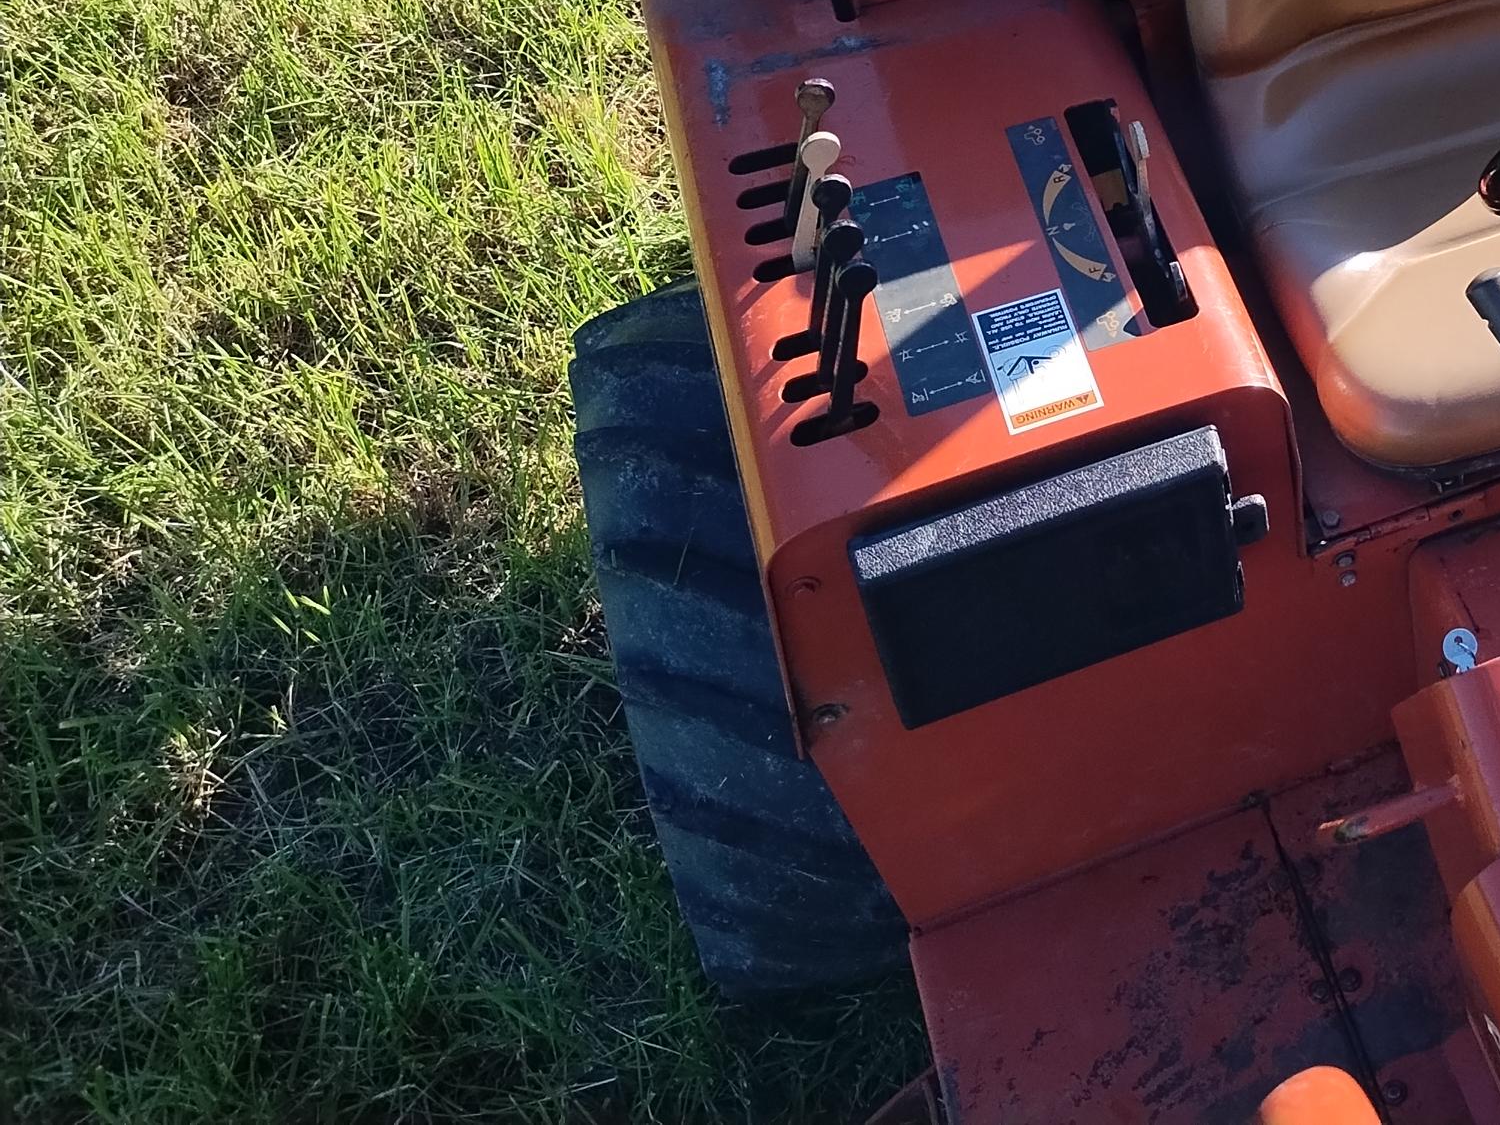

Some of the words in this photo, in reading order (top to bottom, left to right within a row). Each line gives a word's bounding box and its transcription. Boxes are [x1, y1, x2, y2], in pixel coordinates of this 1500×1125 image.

[1053, 174, 1066, 184] R
[1046, 226, 1060, 235] N
[1015, 399, 1075, 424] WARNING
